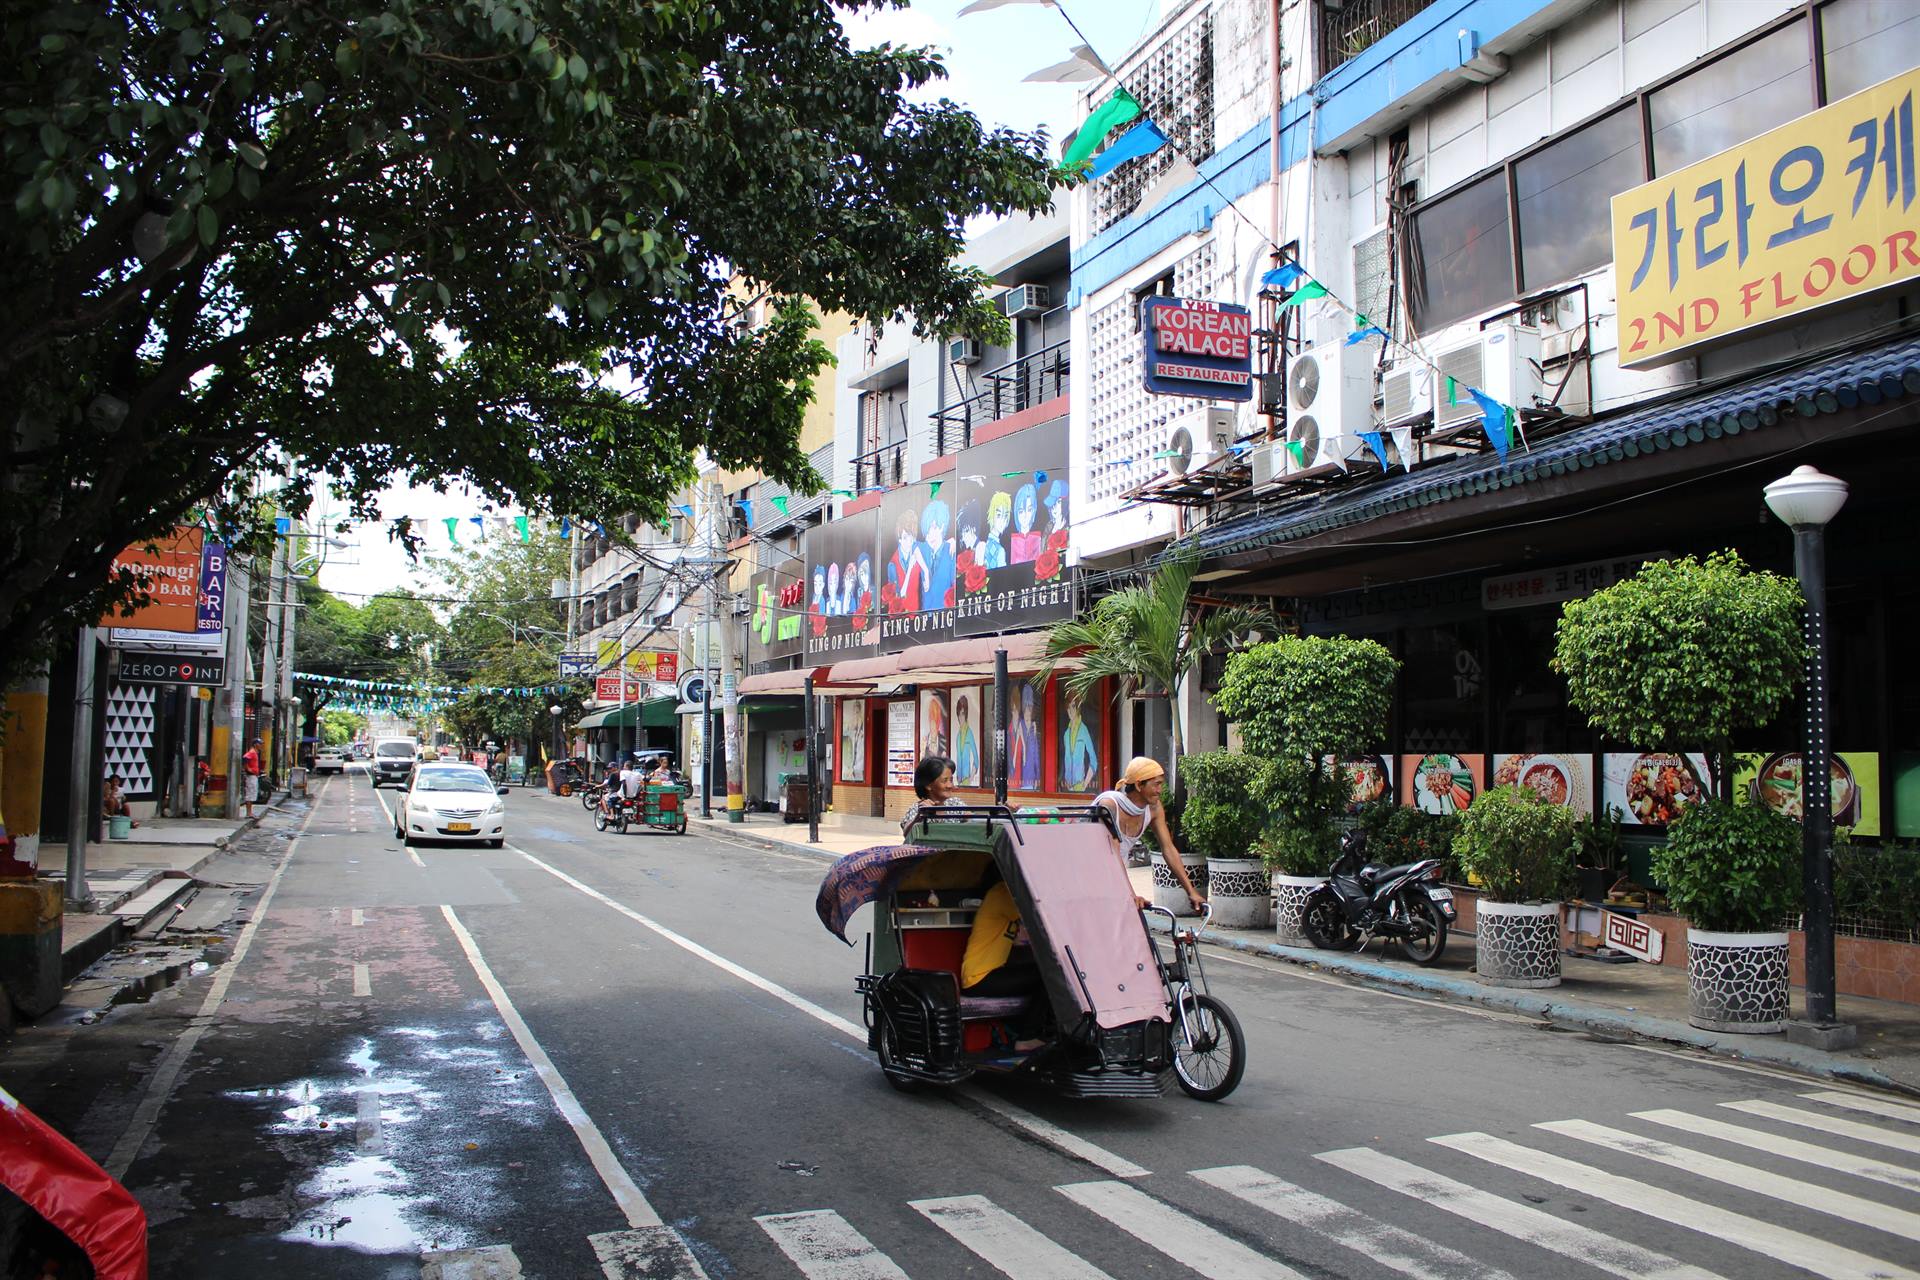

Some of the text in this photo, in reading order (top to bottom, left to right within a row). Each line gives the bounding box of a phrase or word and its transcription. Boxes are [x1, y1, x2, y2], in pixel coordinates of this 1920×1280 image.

[1629, 88, 1917, 294] 가라오케
[1628, 230, 1920, 353] 2ND FLOOR
[1185, 301, 1217, 313] YHL
[1156, 307, 1249, 337] KOREAN
[1160, 329, 1246, 358] PALACE
[1158, 364, 1249, 384] RESTAURANT
[160, 582, 192, 596] BAR
[207, 556, 223, 611] BAR
[958, 581, 1071, 618] KING OF NIGHT
[882, 617, 910, 638] KING
[932, 610, 954, 630] NIG
[809, 636, 829, 654] KING
